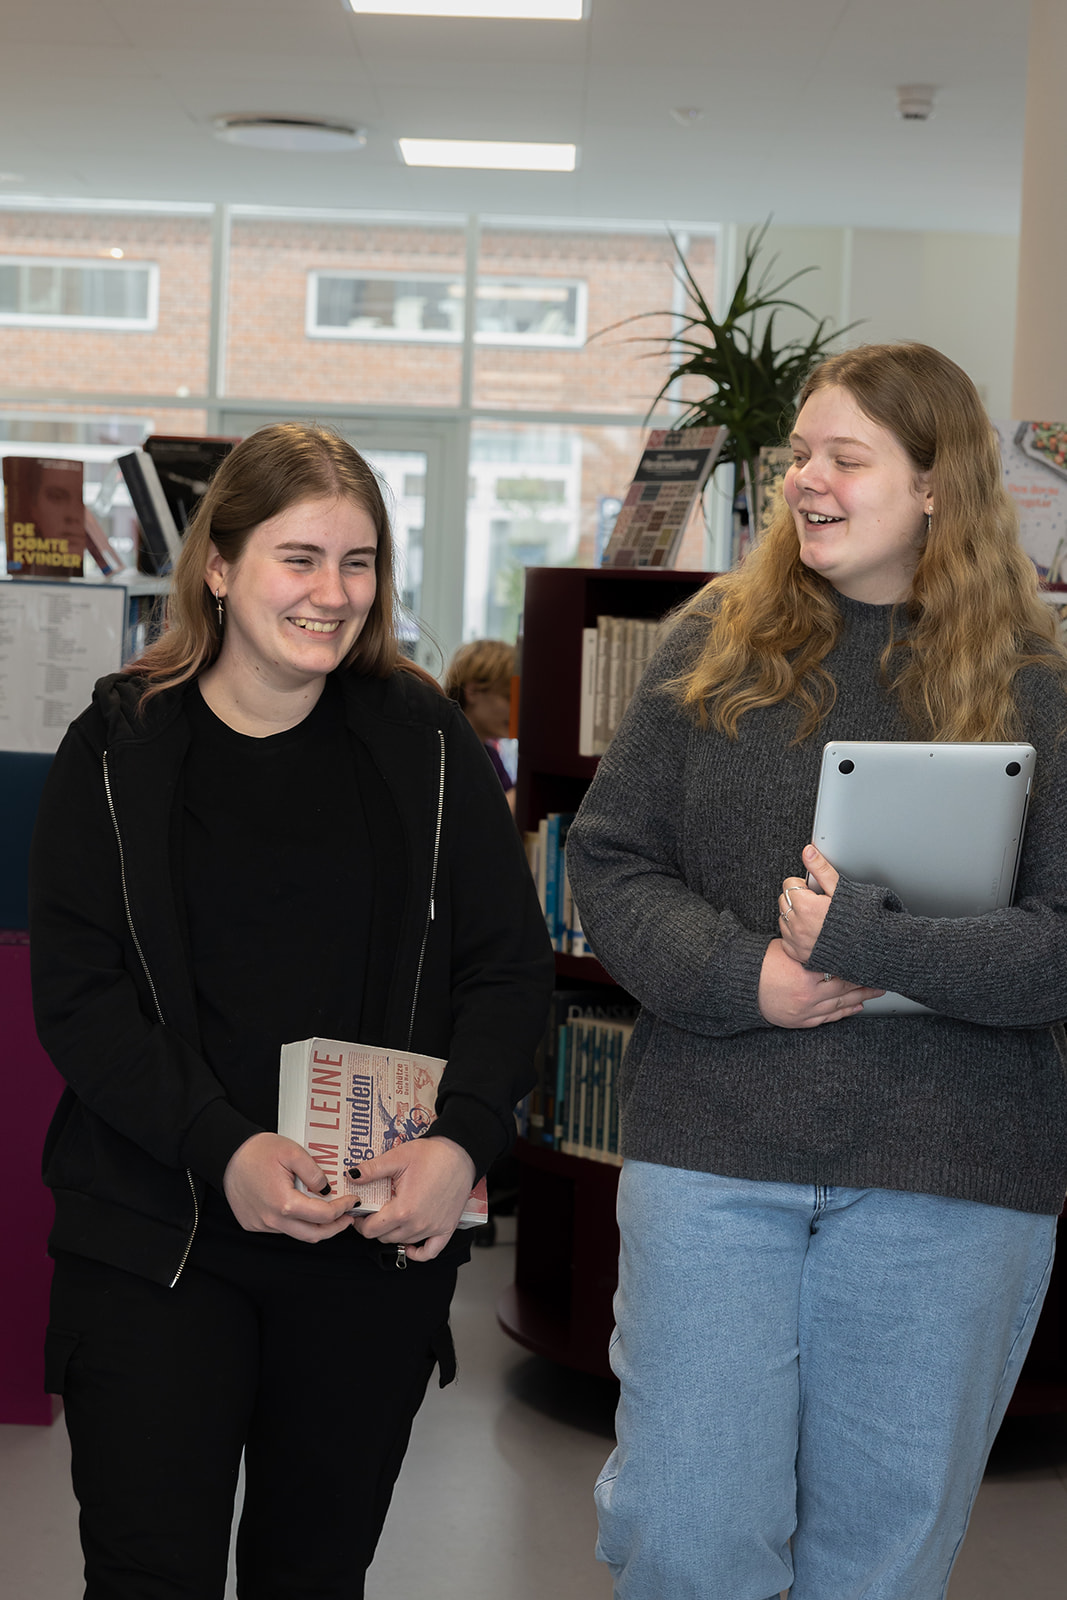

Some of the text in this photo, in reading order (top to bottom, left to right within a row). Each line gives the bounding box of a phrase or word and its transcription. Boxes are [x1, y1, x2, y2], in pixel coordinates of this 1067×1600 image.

[13, 522, 35, 537] DE
[13, 551, 81, 569] KVINDER
[310, 1050, 343, 1129] LEINE
[395, 1063, 404, 1095] Schütze
[343, 1075, 375, 1177] fgrunden
